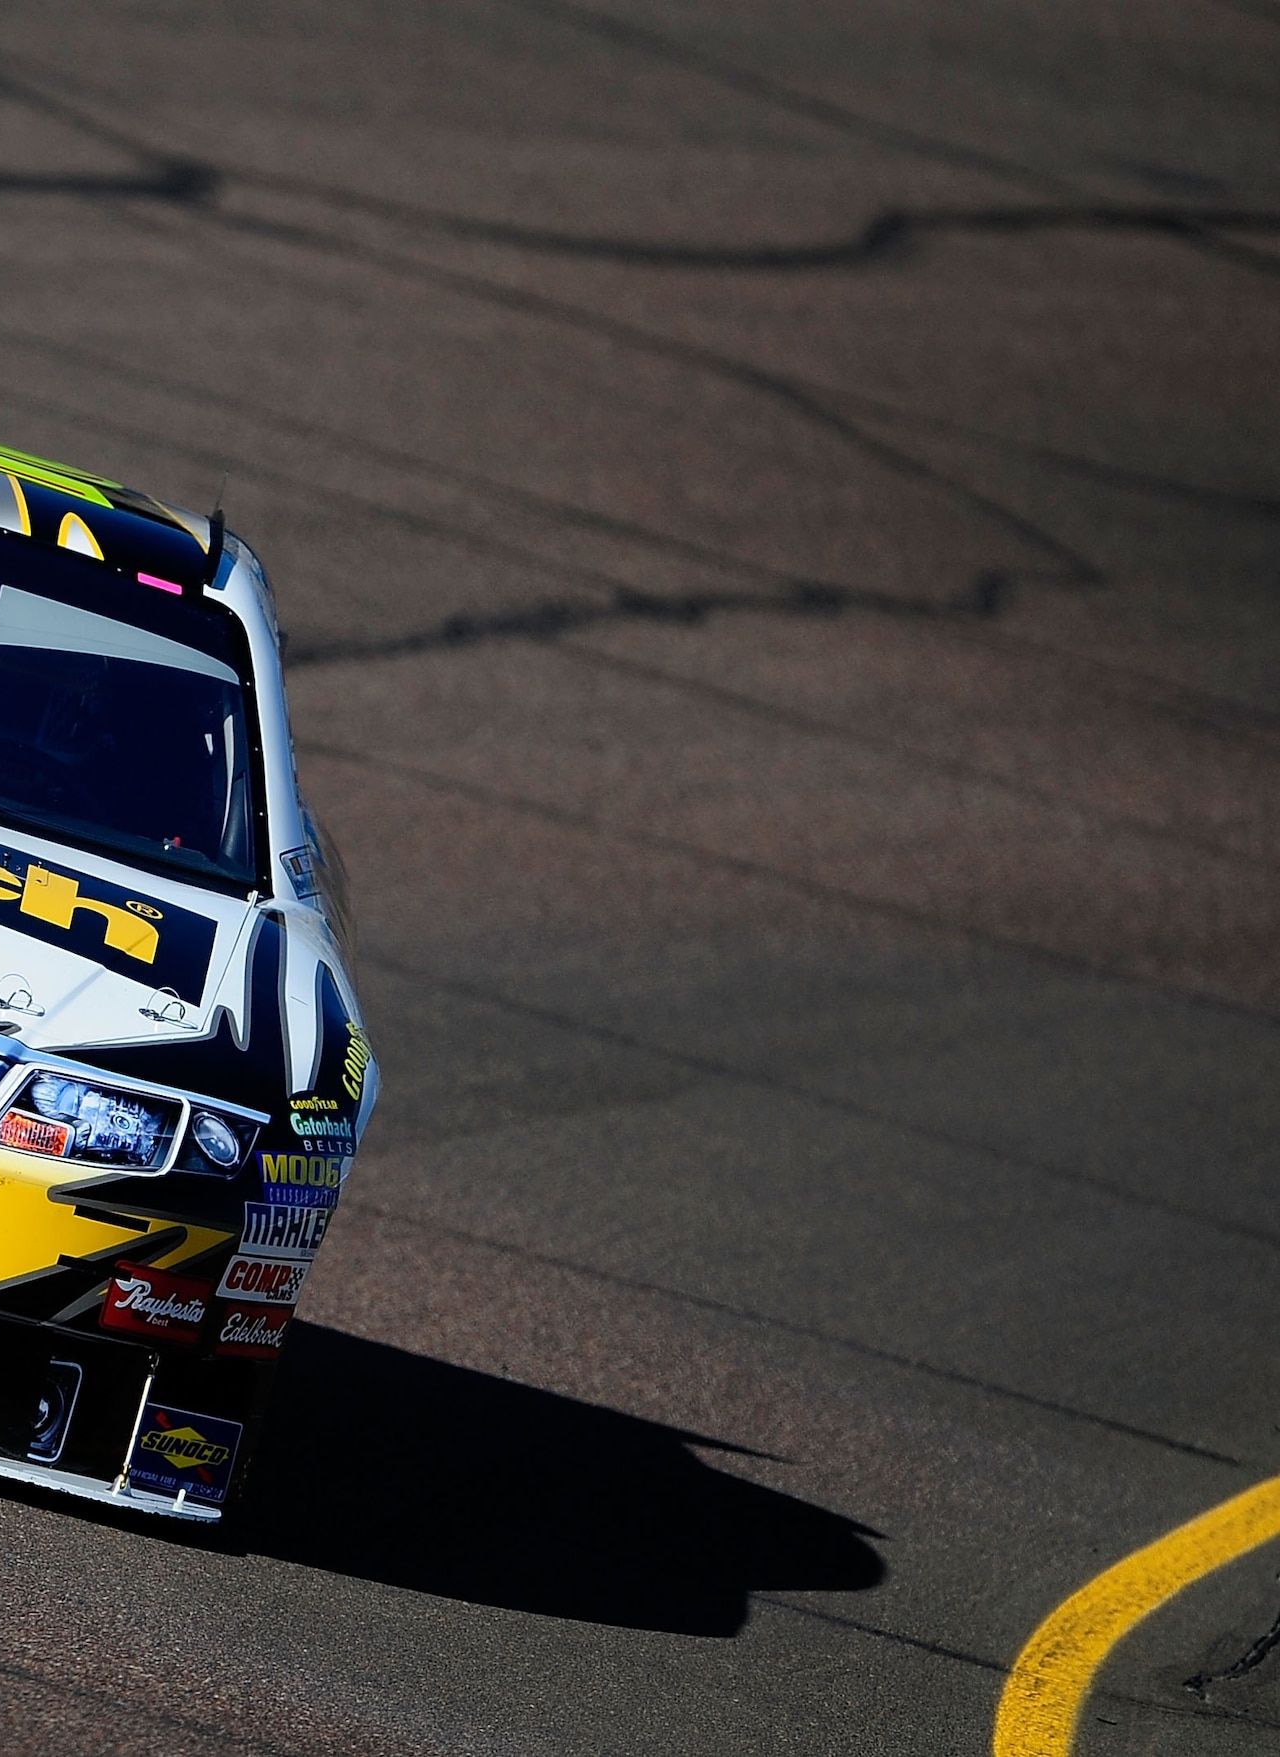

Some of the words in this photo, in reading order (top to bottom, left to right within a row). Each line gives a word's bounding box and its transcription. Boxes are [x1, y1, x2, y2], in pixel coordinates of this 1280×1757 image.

[290, 1097, 338, 1111] GOODYEAR
[290, 1113, 352, 1137] Gatorback
[303, 1140, 352, 1154] BELTS
[262, 1154, 340, 1187] MOOG
[243, 1202, 327, 1248] MAHLE
[226, 1260, 292, 1293] COMP
[115, 1278, 205, 1323] Raybestos
[265, 1289, 294, 1300] CAMS
[151, 1317, 169, 1326] best
[220, 1313, 287, 1347] Edelbrock
[143, 1433, 227, 1463] SUNOCO
